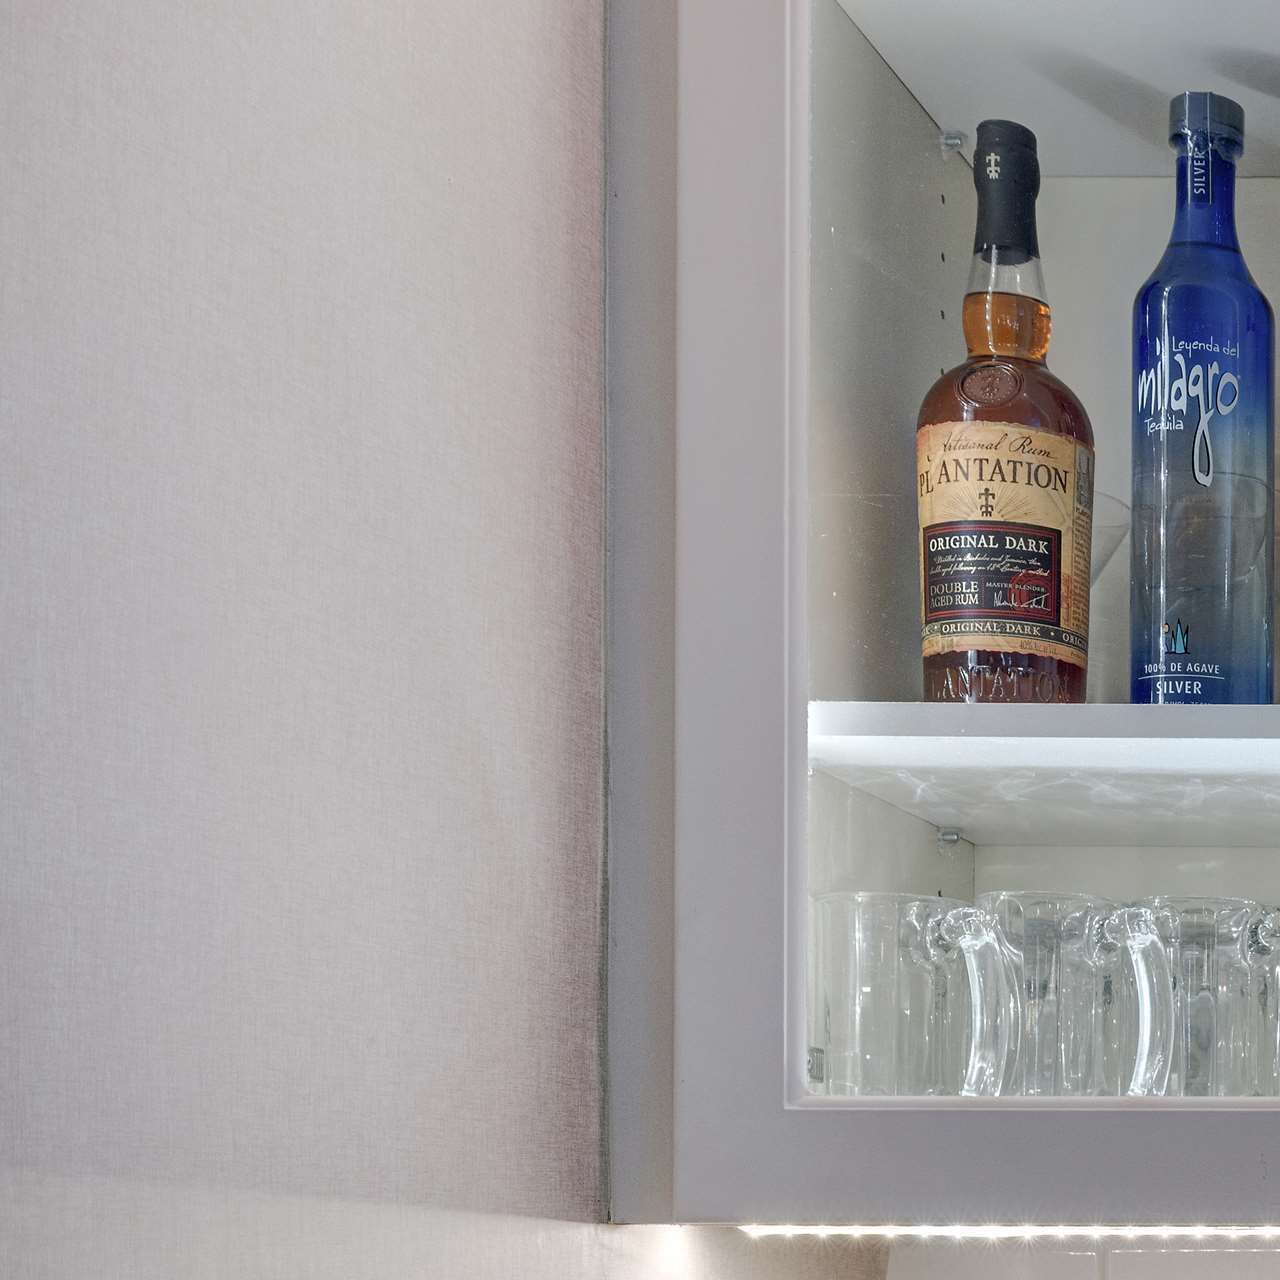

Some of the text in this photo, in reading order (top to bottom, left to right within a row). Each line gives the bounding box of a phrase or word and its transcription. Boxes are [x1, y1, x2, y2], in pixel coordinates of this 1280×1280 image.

[1194, 151, 1206, 194] SILVER
[1172, 336, 1240, 358] Leyenda del
[1138, 319, 1240, 488] milagro
[1144, 414, 1184, 442] Tequila
[944, 432, 1056, 458] Artisanal Rum
[919, 456, 1070, 497] PLANTATION
[930, 534, 1049, 554] ORIGINAL DARK
[930, 581, 979, 596] DOUBLE
[930, 594, 953, 608] AGED
[954, 594, 979, 606] RUM
[942, 622, 1002, 634] ORIGINAL
[1004, 624, 1040, 636] DARK
[1144, 662, 1220, 674] 100% DE AGAVE
[1156, 680, 1202, 694] SILVER
